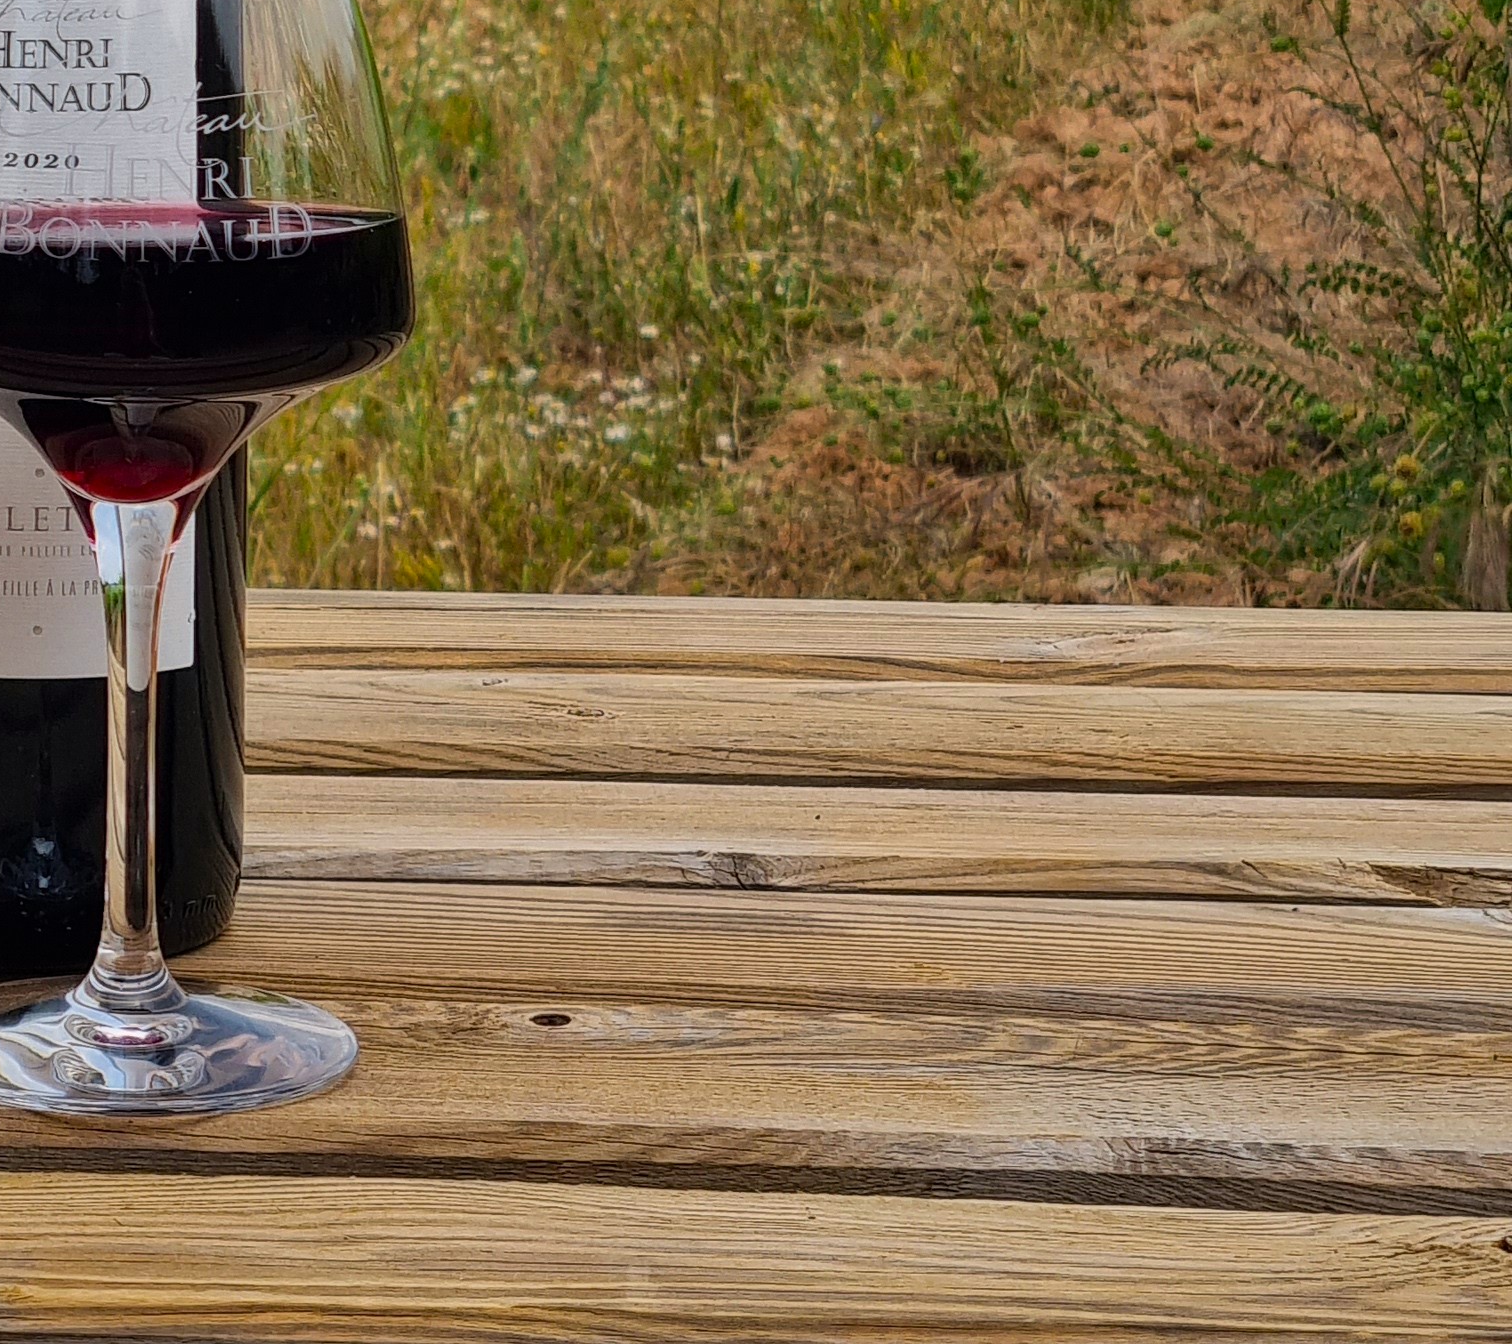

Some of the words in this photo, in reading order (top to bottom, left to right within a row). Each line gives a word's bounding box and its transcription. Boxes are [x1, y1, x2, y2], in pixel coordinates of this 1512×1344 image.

[3, 152, 80, 170] 2020
[57, 142, 256, 200] HENRI
[61, 580, 76, 596] LA
